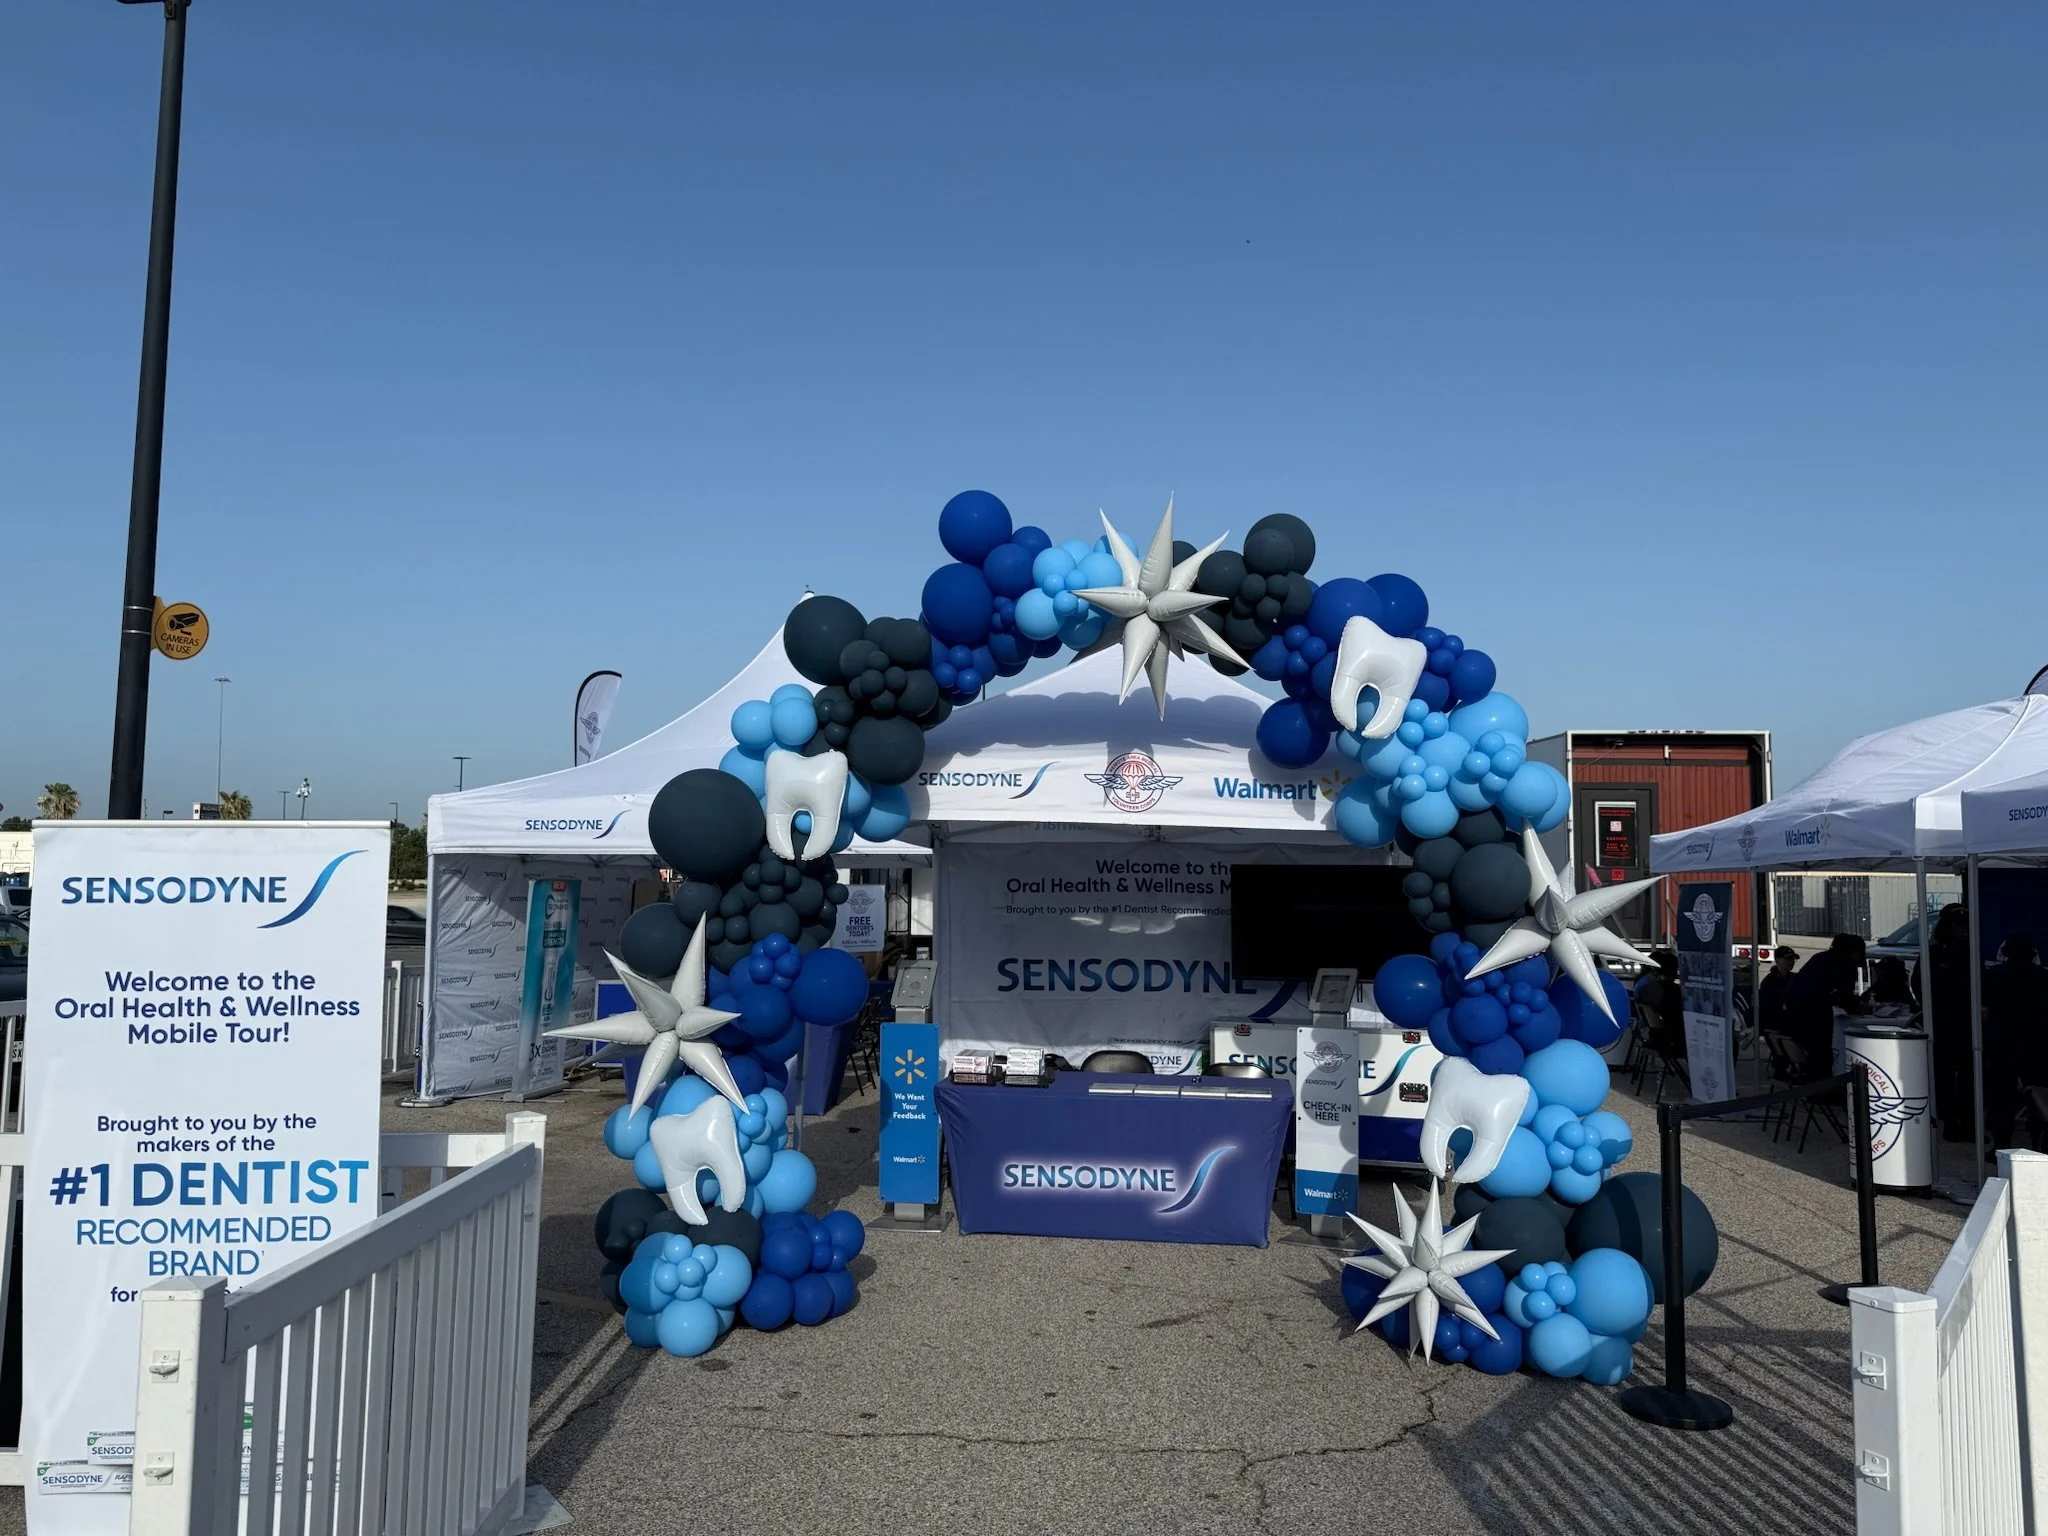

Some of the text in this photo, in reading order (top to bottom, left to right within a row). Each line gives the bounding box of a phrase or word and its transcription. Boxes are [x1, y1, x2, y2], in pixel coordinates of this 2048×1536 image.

[160, 633, 200, 646] CAMERAS
[165, 643, 191, 654] IN USE
[918, 772, 1023, 787] SENSODYNE
[1213, 777, 1317, 800] Walmart
[1111, 796, 1156, 810] VOLUNTEER CORPS
[2008, 806, 2048, 822] SENSODY
[525, 819, 603, 830] SENSODYNE
[1785, 826, 1820, 848] Walmart
[1095, 859, 1231, 875] Welcome to th
[61, 876, 287, 904] SENSODYNE
[1006, 877, 1046, 893] Oral
[1051, 877, 1110, 893] Health
[1116, 877, 1129, 892] &
[1135, 877, 1214, 894] Wellness
[1006, 905, 1044, 915] Brought
[1047, 905, 1056, 913] to
[1059, 906, 1076, 915] you
[1078, 905, 1090, 915] by
[1093, 905, 1109, 913] the
[1111, 905, 1122, 913] #1
[1124, 905, 1158, 914] Dentist
[849, 916, 871, 925] FREE
[104, 970, 316, 992] Welcome to the
[54, 995, 360, 1019] Oral Health & Wellness
[127, 1022, 290, 1044] Mobile Tour!
[1305, 1079, 1337, 1087] SENSODYNE
[1867, 1066, 1890, 1094] DICAL
[906, 1093, 925, 1101] Want
[901, 1102, 918, 1110] Your
[1303, 1100, 1352, 1113] CHECK-IN
[892, 1112, 926, 1120] Feedback
[1315, 1111, 1340, 1121] HERE
[97, 1113, 317, 1136] Brought to you by the
[136, 1135, 276, 1152] makers of the
[49, 1160, 369, 1207] #1 DENTIST
[1003, 1163, 1177, 1192] SENSODYNE
[1303, 1187, 1338, 1200] Walmart
[76, 1215, 331, 1246] RECOMMENDED
[110, 1286, 138, 1302] for
[91, 1446, 135, 1455] SENSOD
[42, 1474, 103, 1485] SENSODYNE
